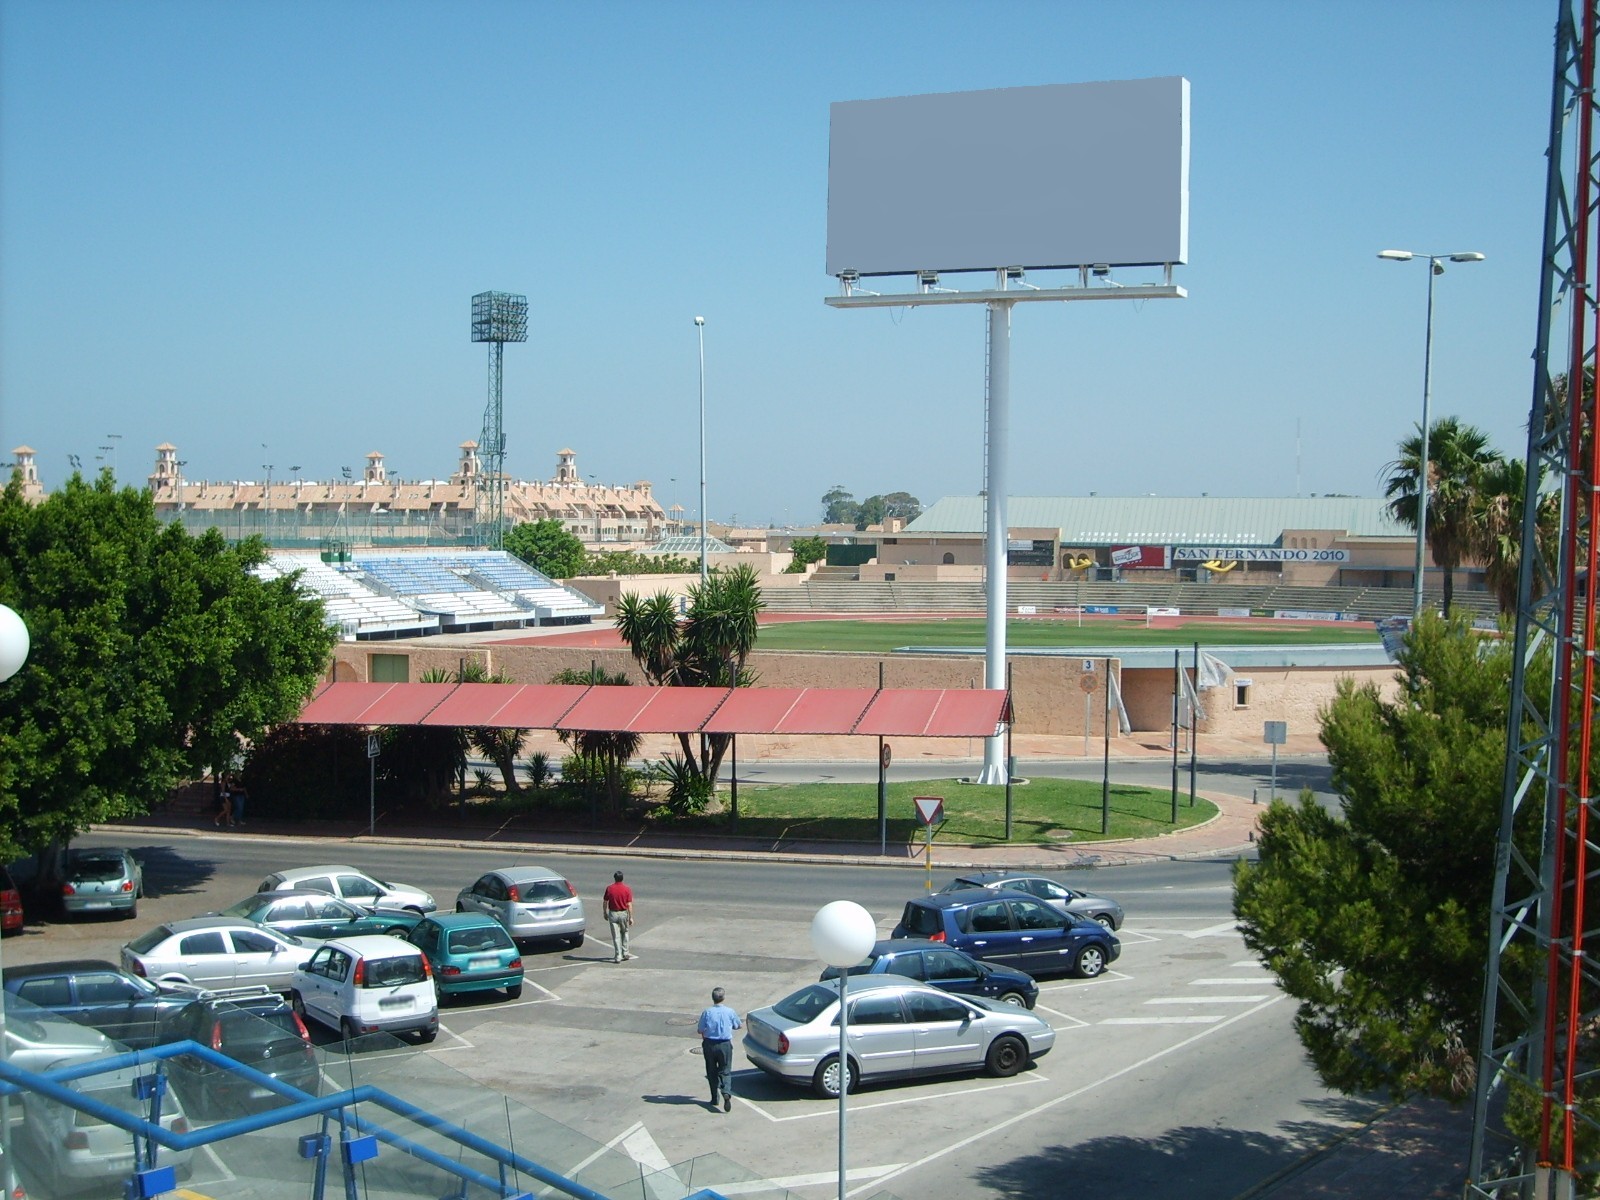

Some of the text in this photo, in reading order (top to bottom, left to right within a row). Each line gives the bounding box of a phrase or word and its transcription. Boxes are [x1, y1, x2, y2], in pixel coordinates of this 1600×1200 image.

[1177, 548, 1344, 560] SAN FERNANDO 2010
[1085, 660, 1091, 669] 3
